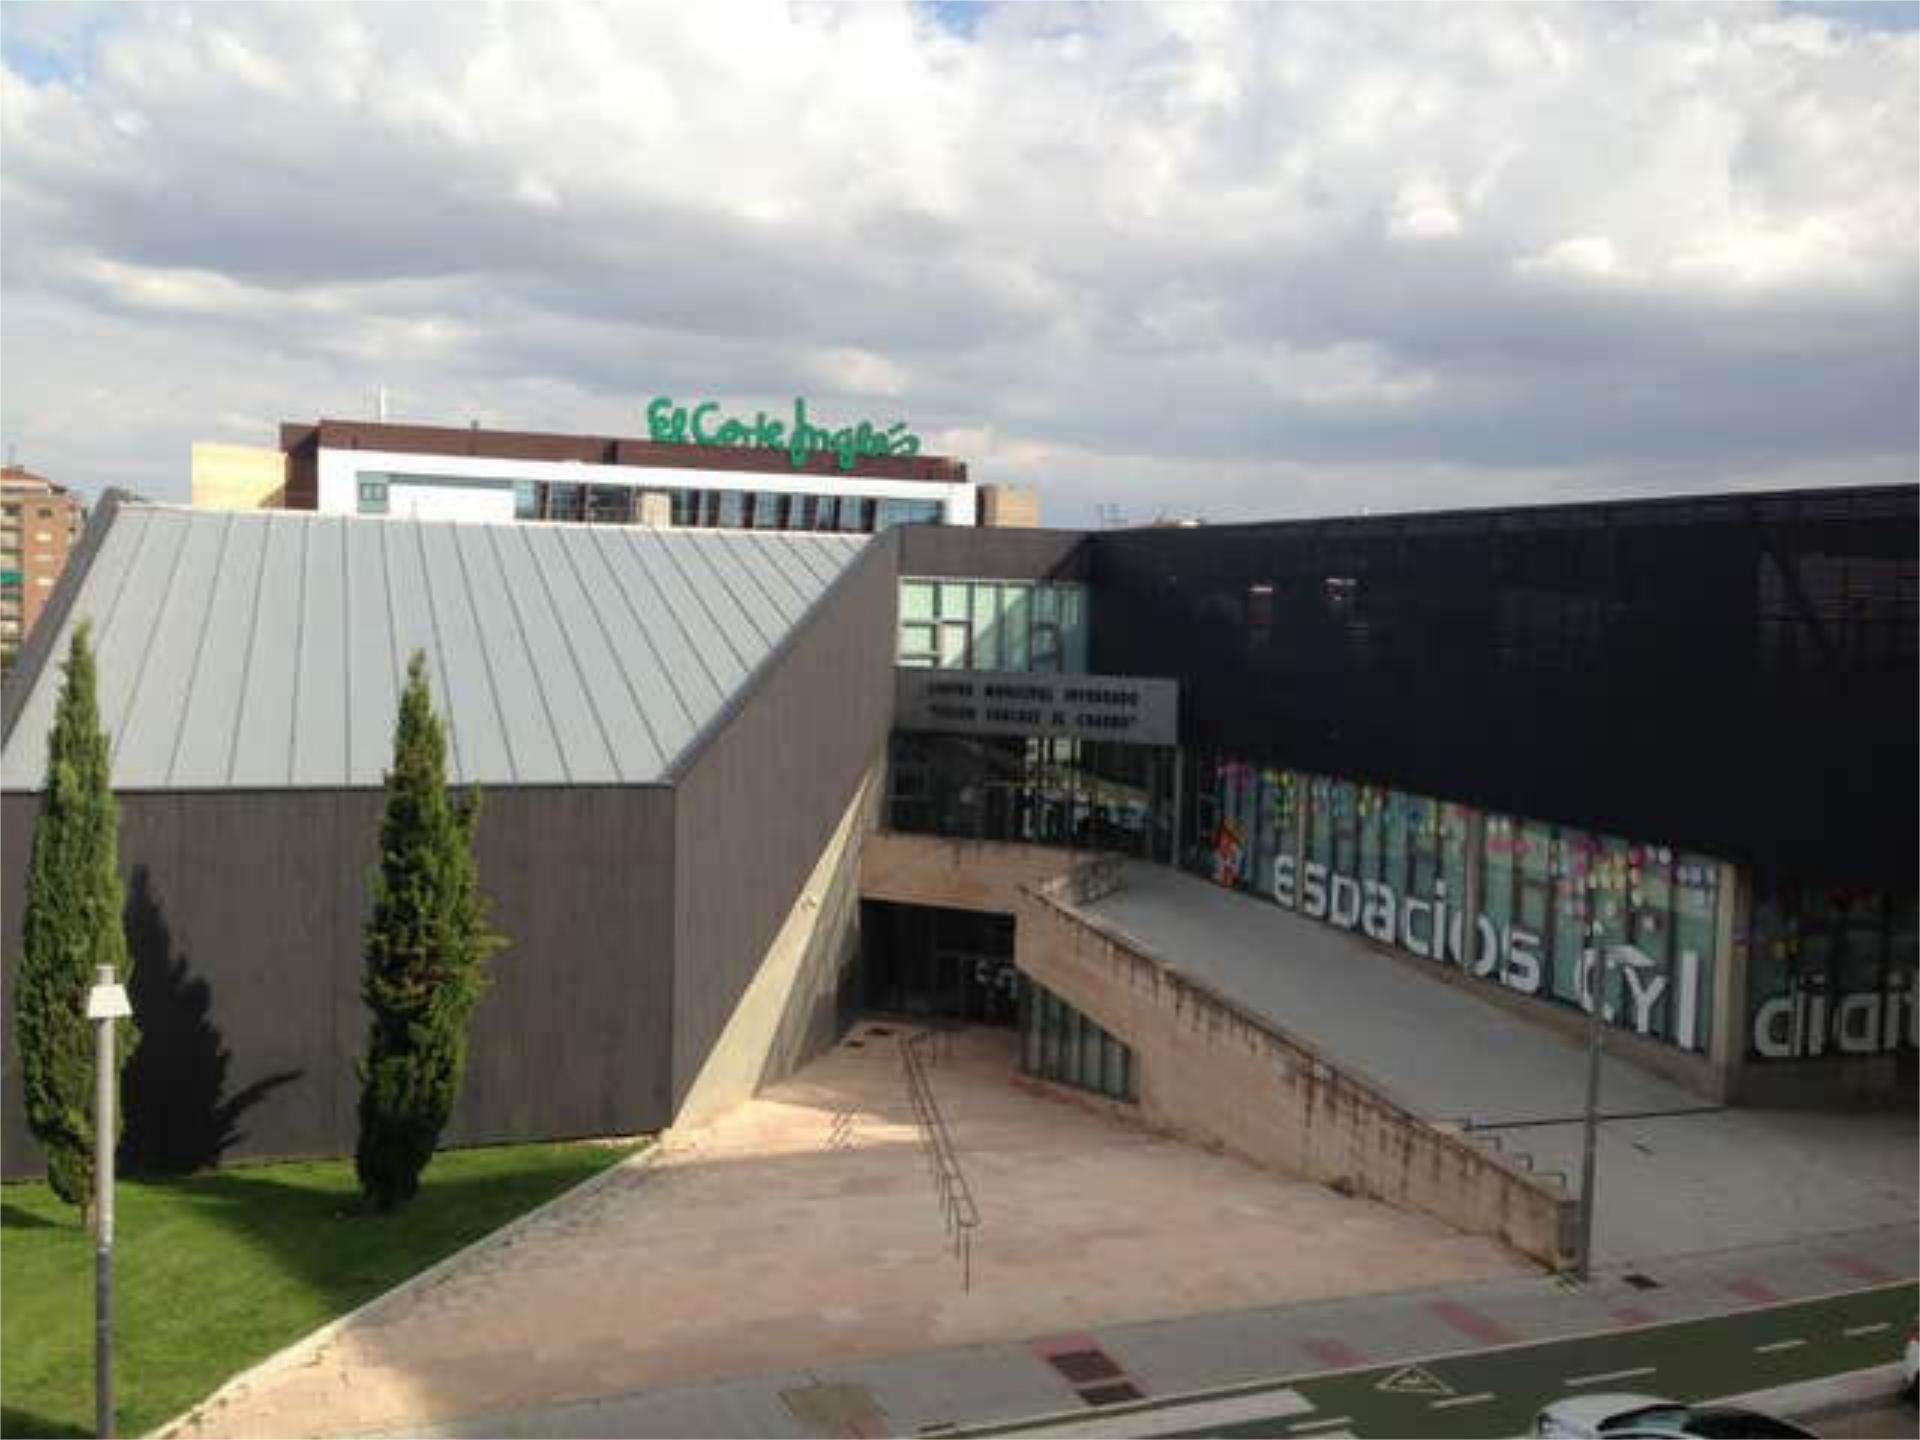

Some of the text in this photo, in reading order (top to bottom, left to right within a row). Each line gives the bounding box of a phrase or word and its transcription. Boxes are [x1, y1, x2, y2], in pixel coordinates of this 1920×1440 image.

[647, 397, 920, 469] El Corte Inglés
